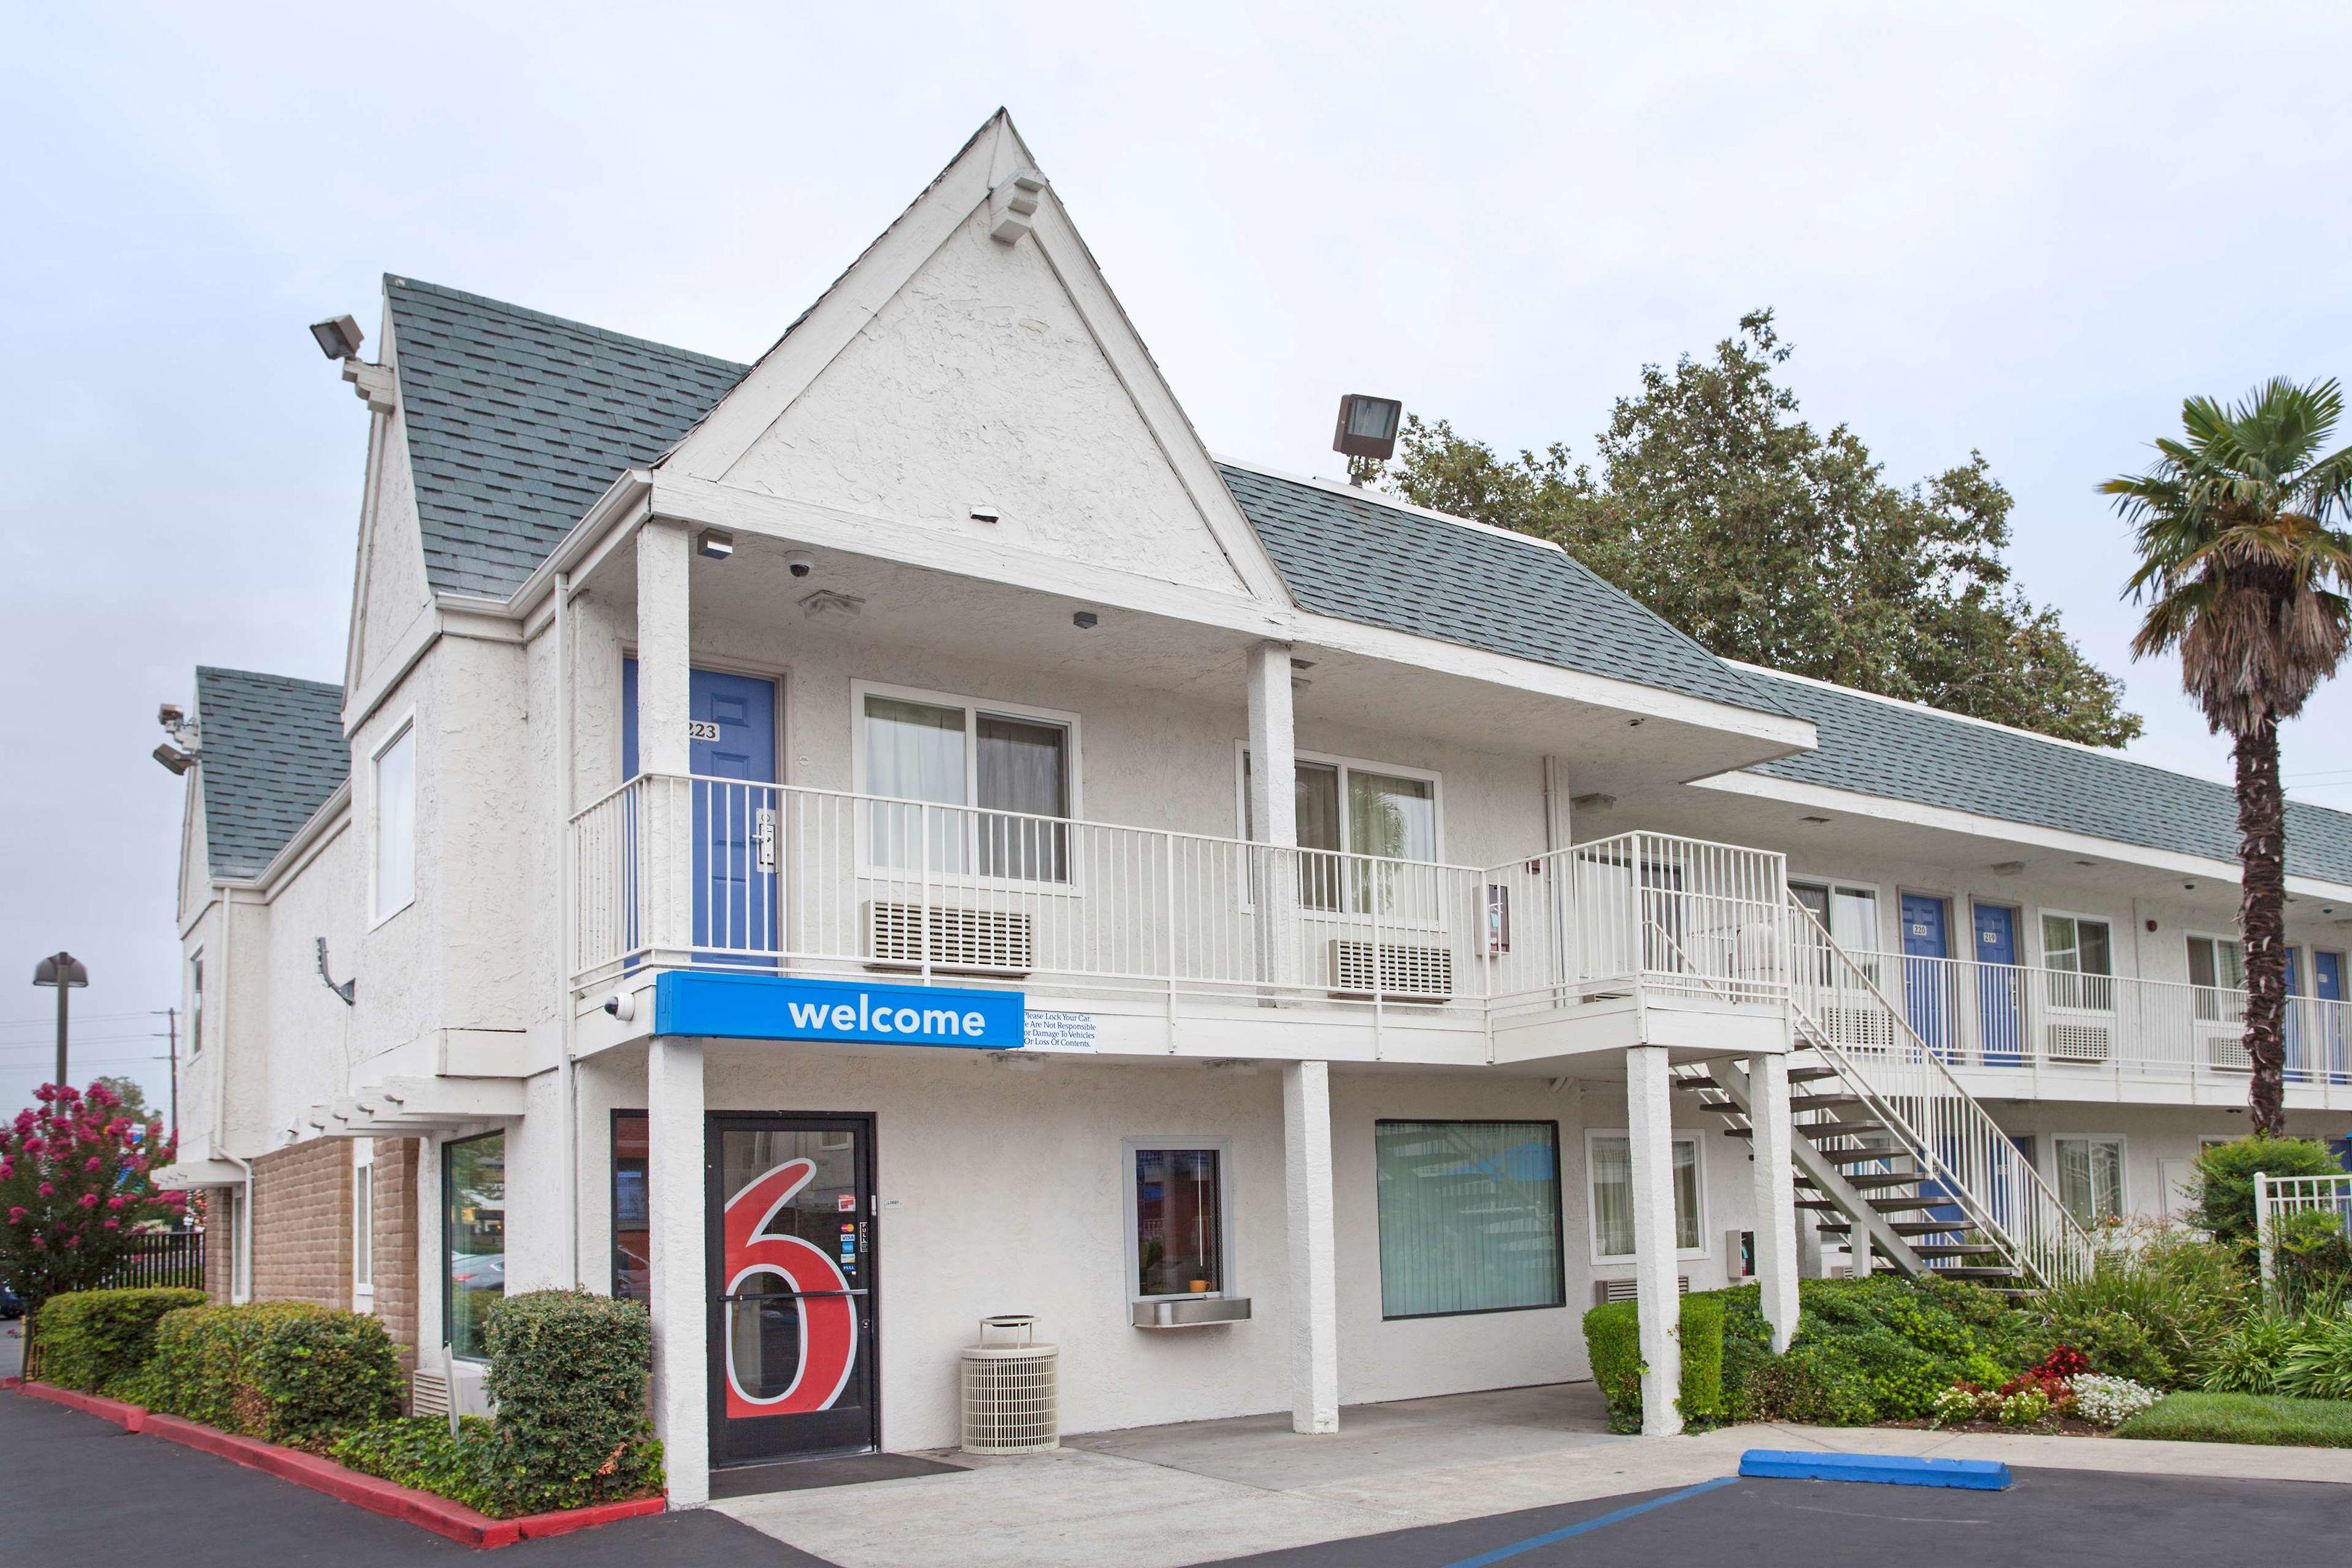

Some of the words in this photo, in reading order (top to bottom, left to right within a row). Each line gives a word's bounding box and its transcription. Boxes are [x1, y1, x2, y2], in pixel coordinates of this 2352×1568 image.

[1914, 926, 1926, 934] 220
[788, 993, 986, 1037] welcome
[1057, 1022, 1097, 1031] Responsible
[1032, 1029, 1060, 1039] Damage
[725, 1158, 858, 1418] 6
